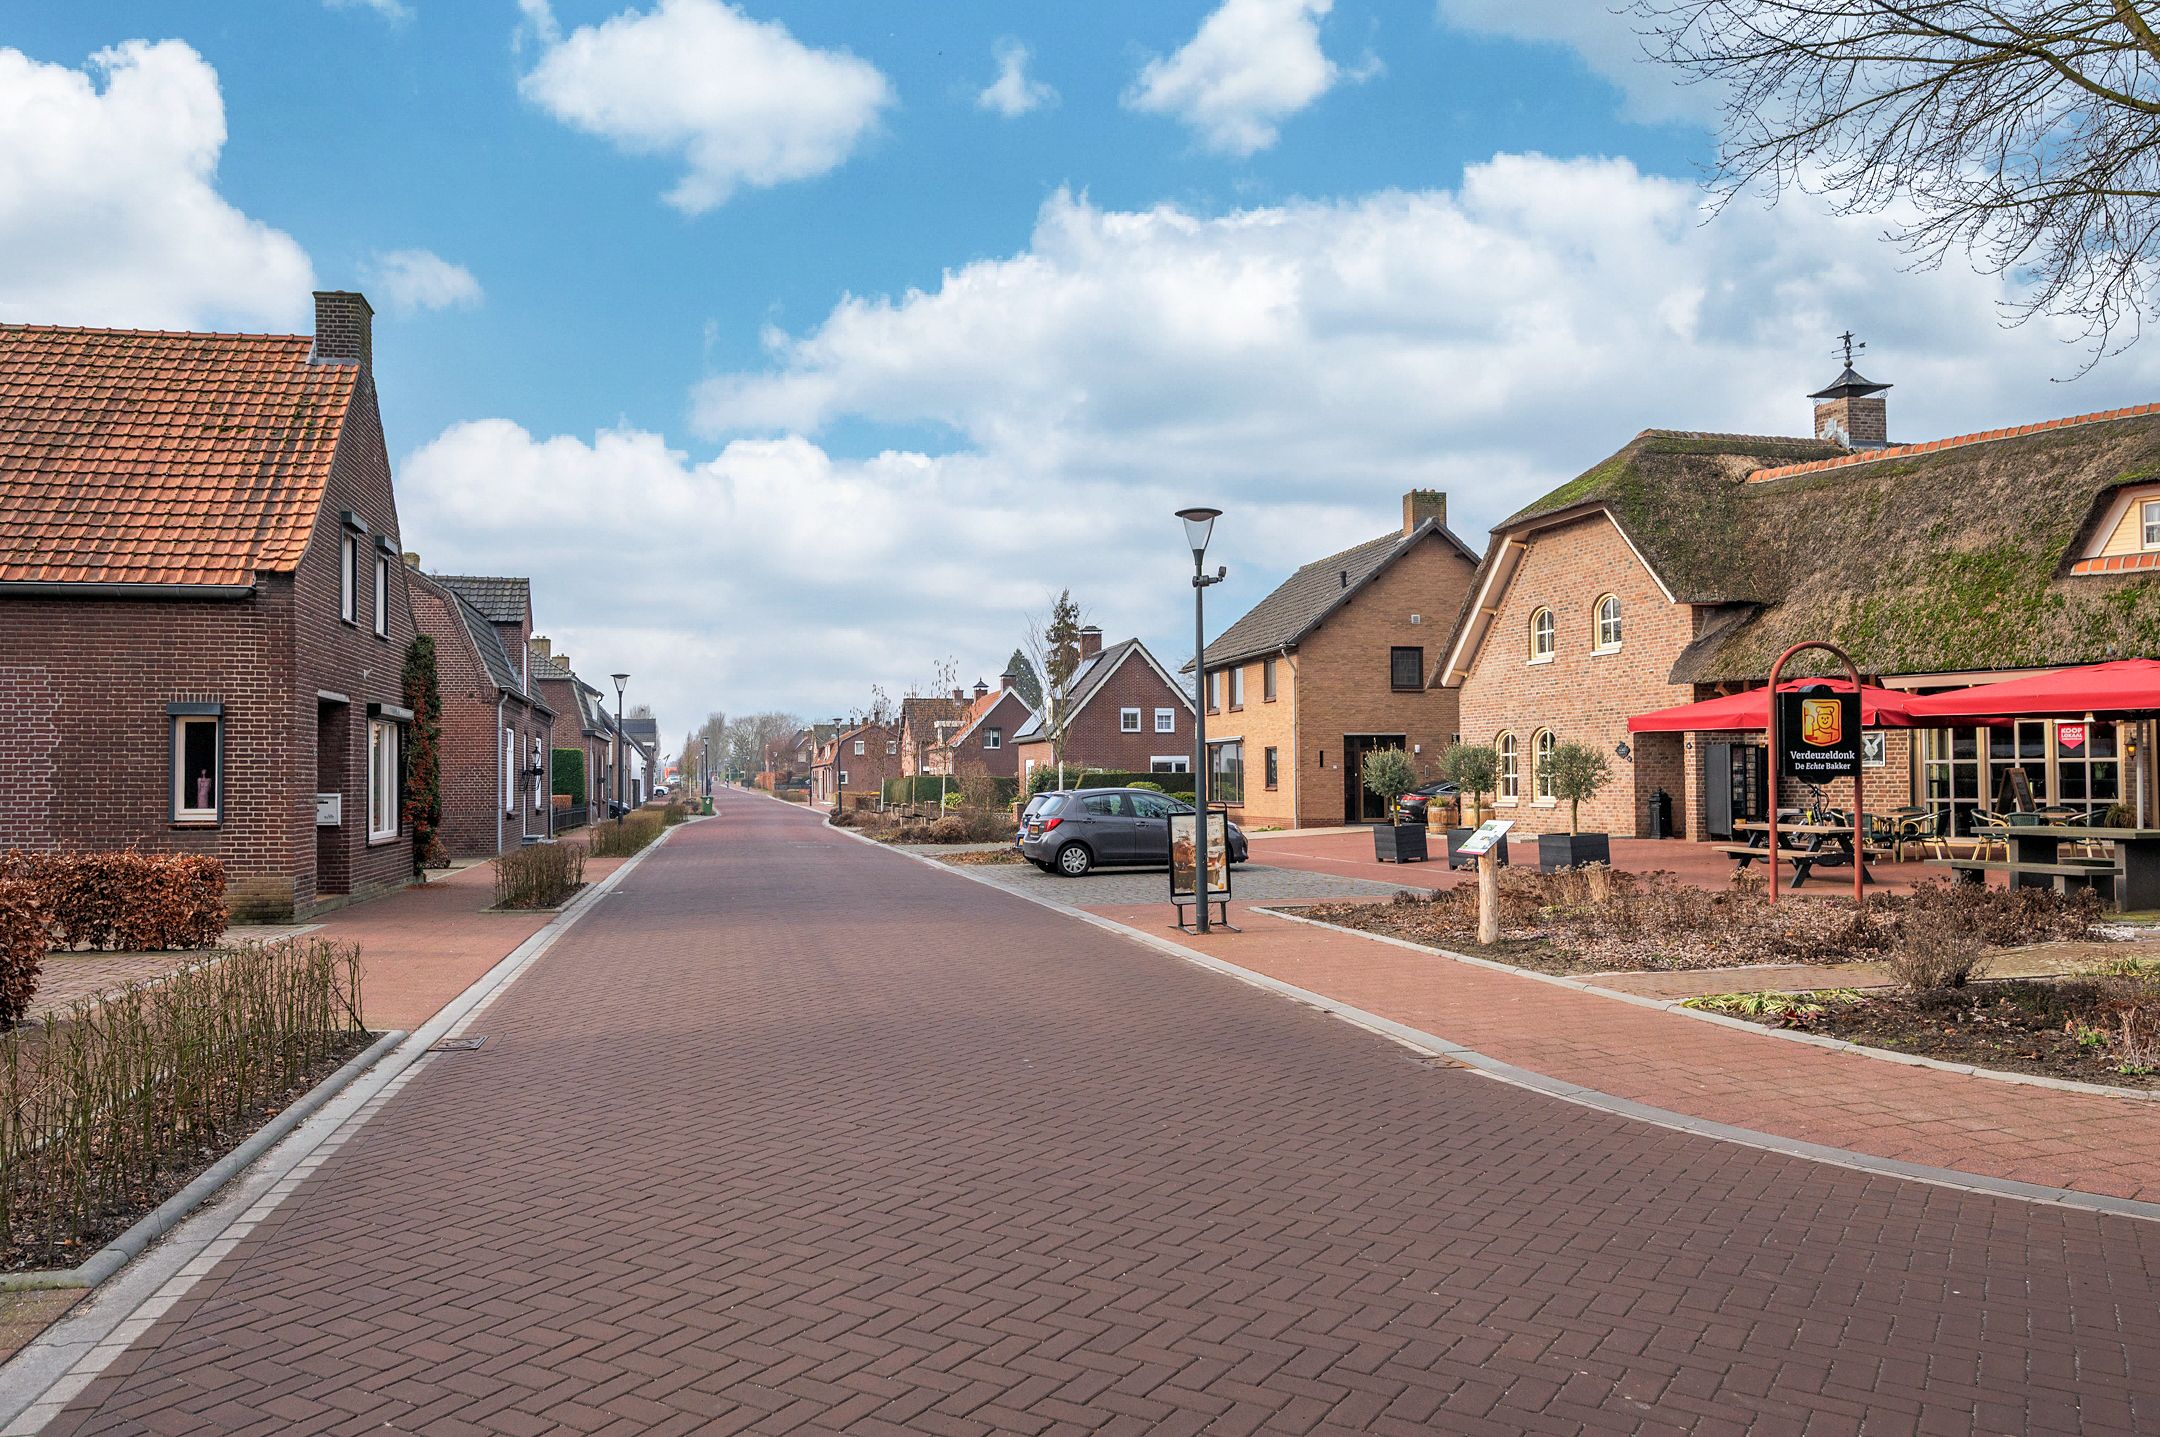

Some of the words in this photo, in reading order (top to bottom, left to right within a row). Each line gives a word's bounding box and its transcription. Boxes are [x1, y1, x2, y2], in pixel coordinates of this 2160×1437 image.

[1790, 750, 1855, 760] Verdeuzeldonk
[1795, 762, 1805, 770] De
[1806, 762, 1825, 770] Echte
[1825, 762, 1851, 770] Bakker
